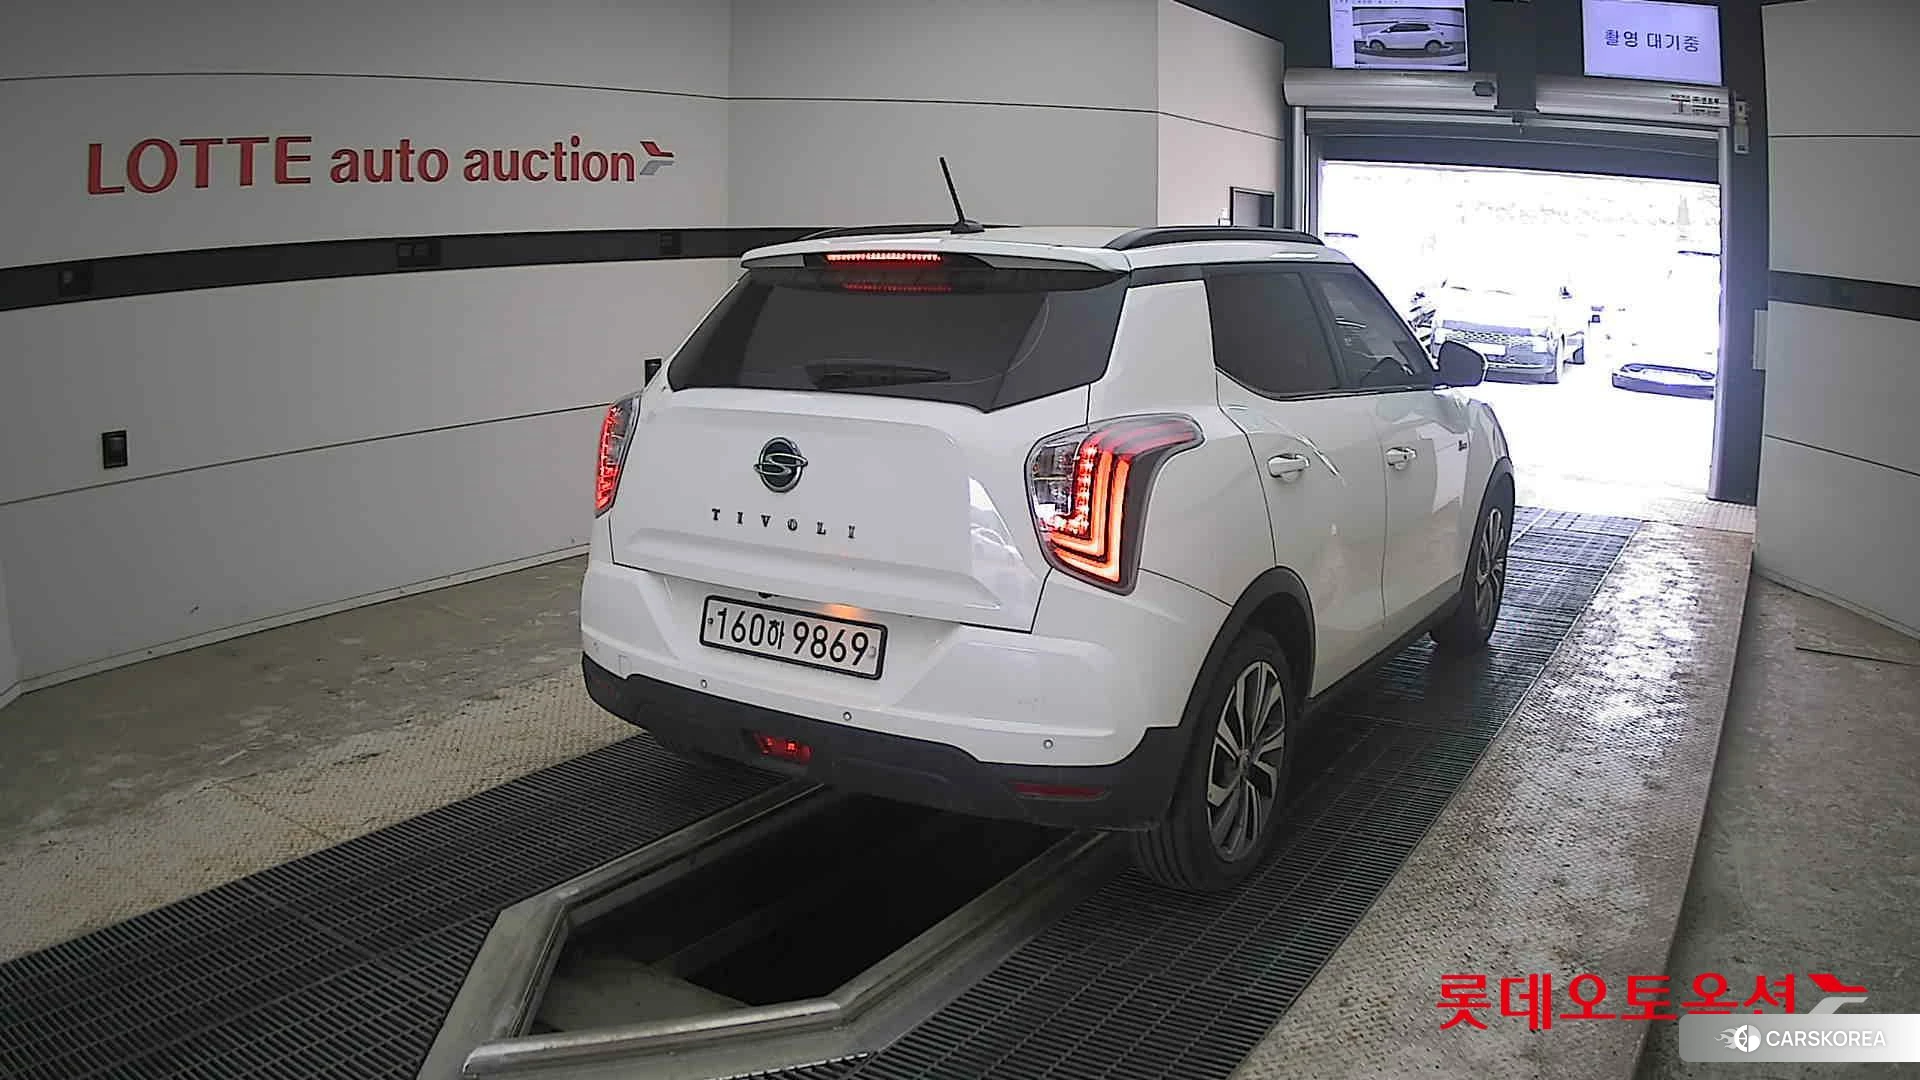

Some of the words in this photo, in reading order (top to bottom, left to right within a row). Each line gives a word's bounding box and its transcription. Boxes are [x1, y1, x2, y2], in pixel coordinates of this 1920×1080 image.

[1647, 33, 1700, 52] 대기중
[88, 136, 312, 194] LOTTE
[329, 138, 449, 184] auto
[463, 135, 635, 183] auction
[711, 508, 856, 539] TIVOLI
[717, 607, 785, 650] 160하
[793, 621, 869, 666] 9869
